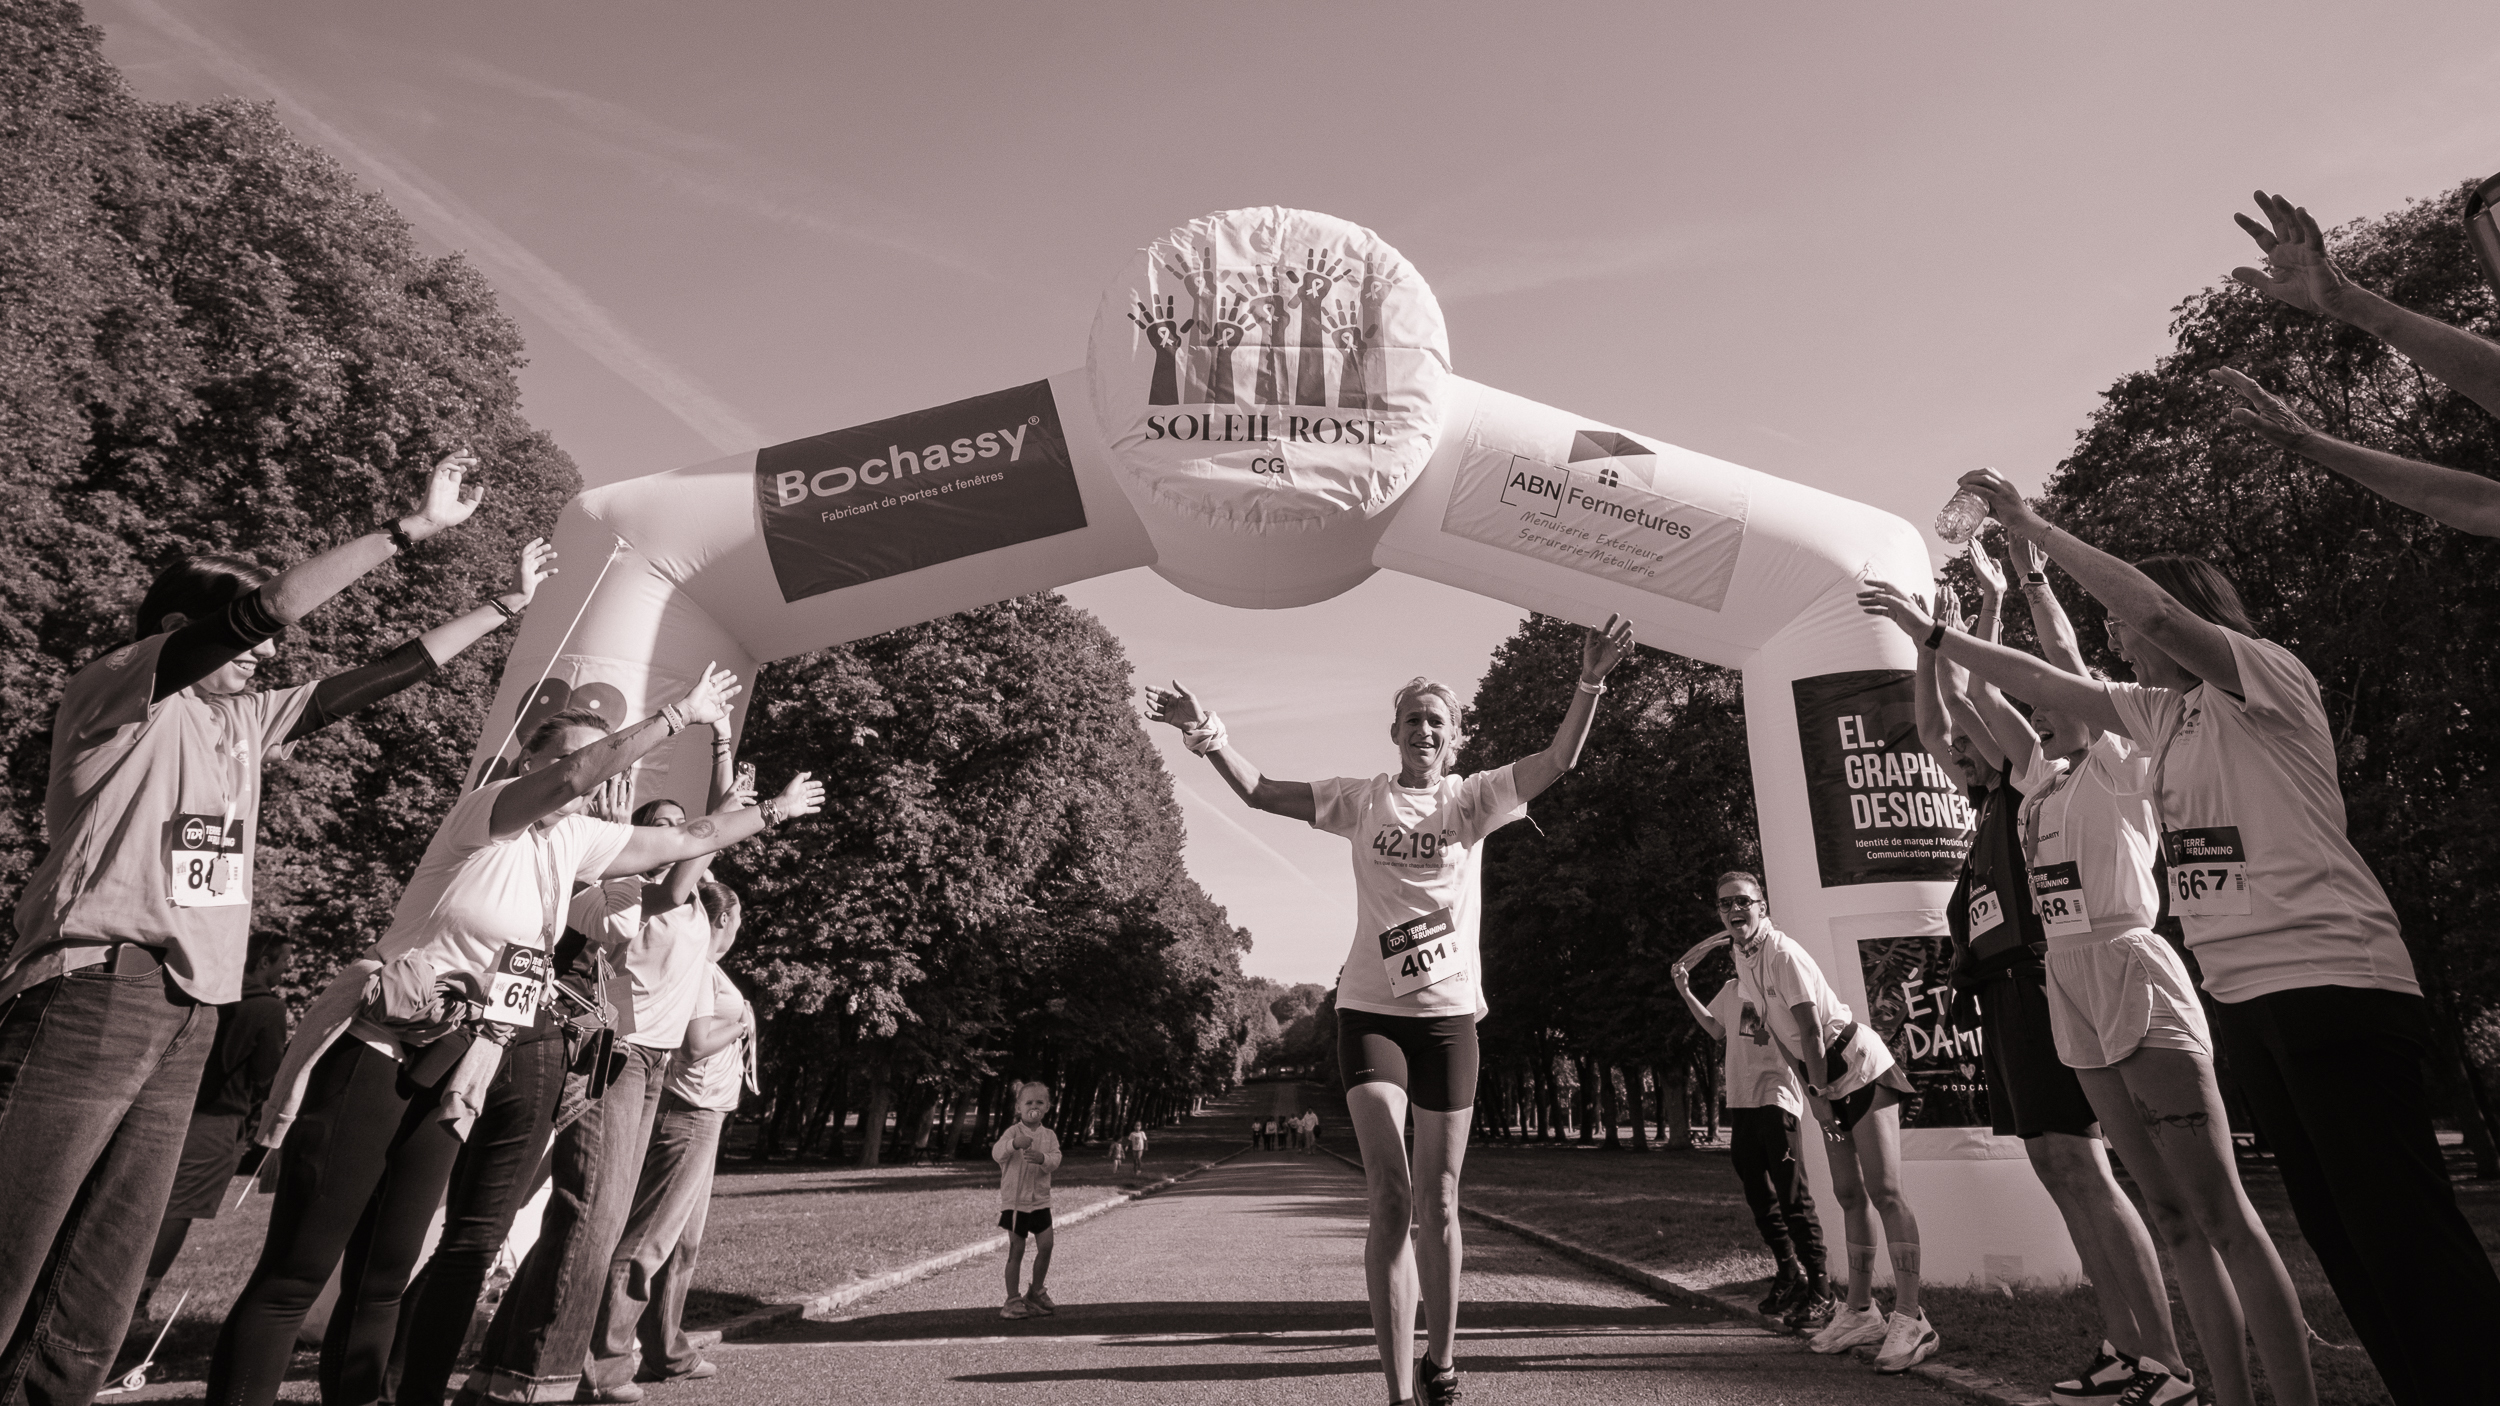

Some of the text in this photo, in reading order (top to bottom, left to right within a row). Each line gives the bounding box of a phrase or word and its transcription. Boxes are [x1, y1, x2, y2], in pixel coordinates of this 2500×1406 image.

[1145, 413, 1387, 446] SOLEIL ROSE
[1251, 457, 1285, 475] CG
[821, 471, 1004, 523] Fabricant de portes et fenêtres
[1509, 472, 1692, 540] ABN Fermetures
[1520, 511, 1664, 562] Menuiserie Extérieure
[1518, 528, 1655, 578] Serrurerie-Métallerie
[1838, 715, 1885, 750] EL.
[1855, 838, 1889, 848] Identité
[1891, 837, 1902, 846] de
[1904, 838, 1934, 847] marque
[1940, 837, 1963, 847] Motion
[1866, 849, 1930, 860] Communication
[1932, 849, 1950, 860] print
[2183, 838, 2206, 848] TERRE
[2192, 846, 2234, 856] RUNNING
[2178, 869, 2229, 901] 667
[1389, 934, 1406, 947] TDR
[1406, 923, 1427, 936] TERRE
[1418, 923, 1447, 940] RUNNING
[1400, 942, 1447, 978] 401
